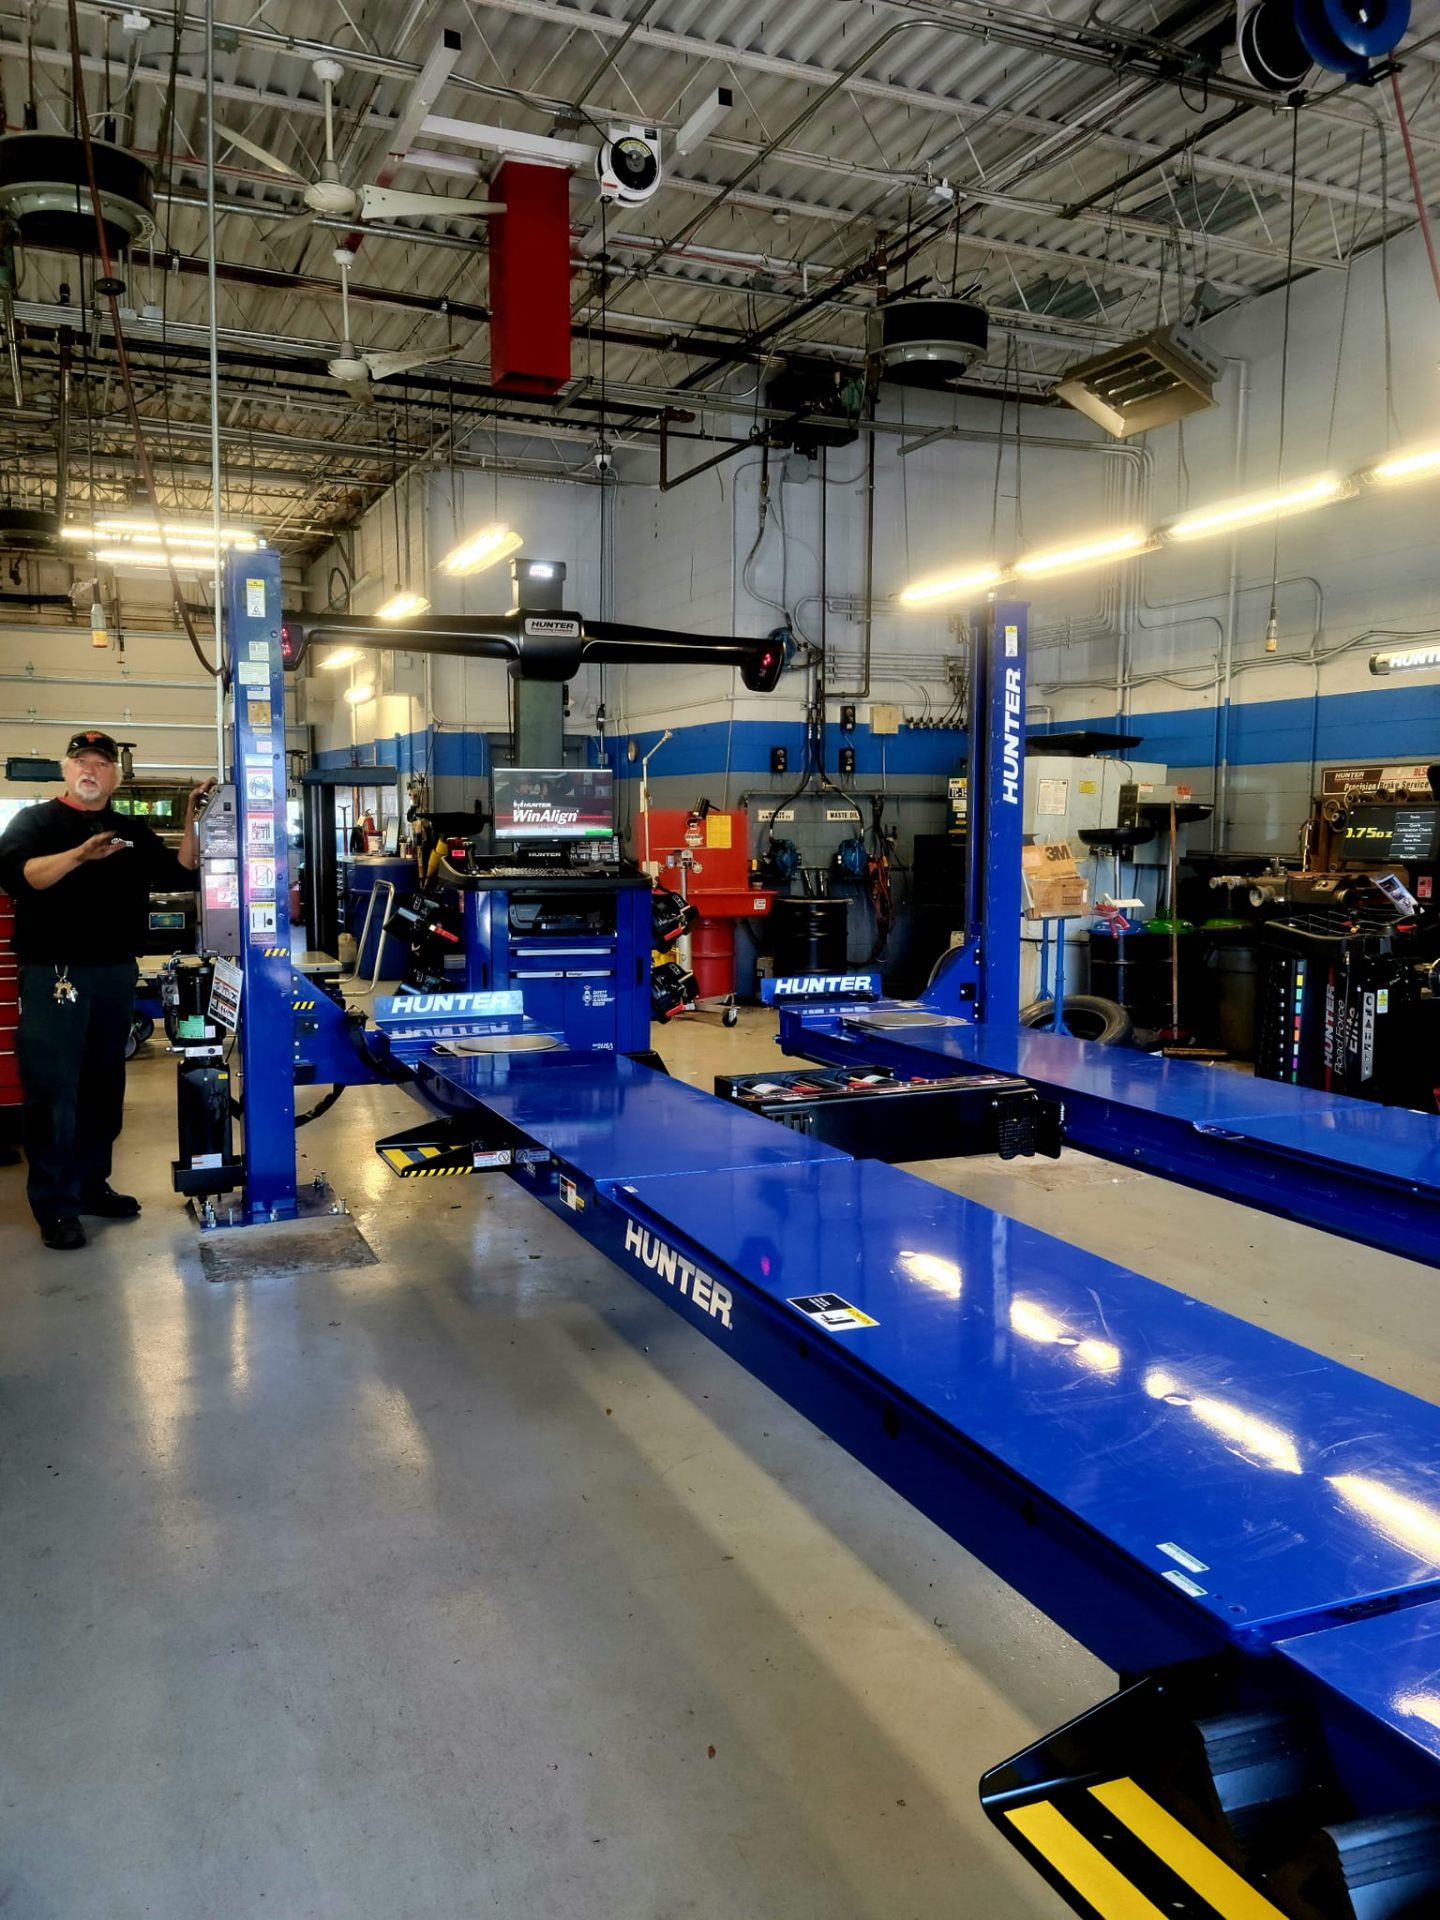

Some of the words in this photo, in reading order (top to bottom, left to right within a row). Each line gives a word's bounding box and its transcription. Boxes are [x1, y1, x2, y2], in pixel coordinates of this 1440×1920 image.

[531, 621, 574, 630] HUNTER
[1003, 668, 1021, 805] HUNTER
[1335, 771, 1365, 779] HUNTER
[1380, 781, 1400, 789] Brake
[1402, 780, 1428, 789] Service
[513, 809, 577, 824] WinAlign
[1044, 844, 1071, 862] 3M
[774, 976, 872, 994] HUNTER
[391, 993, 511, 1014] HUNTER
[1324, 984, 1335, 1068] HUNTER
[1335, 999, 1345, 1038] Force
[1334, 1040, 1344, 1075] Road
[625, 1218, 733, 1330] HUNTER
